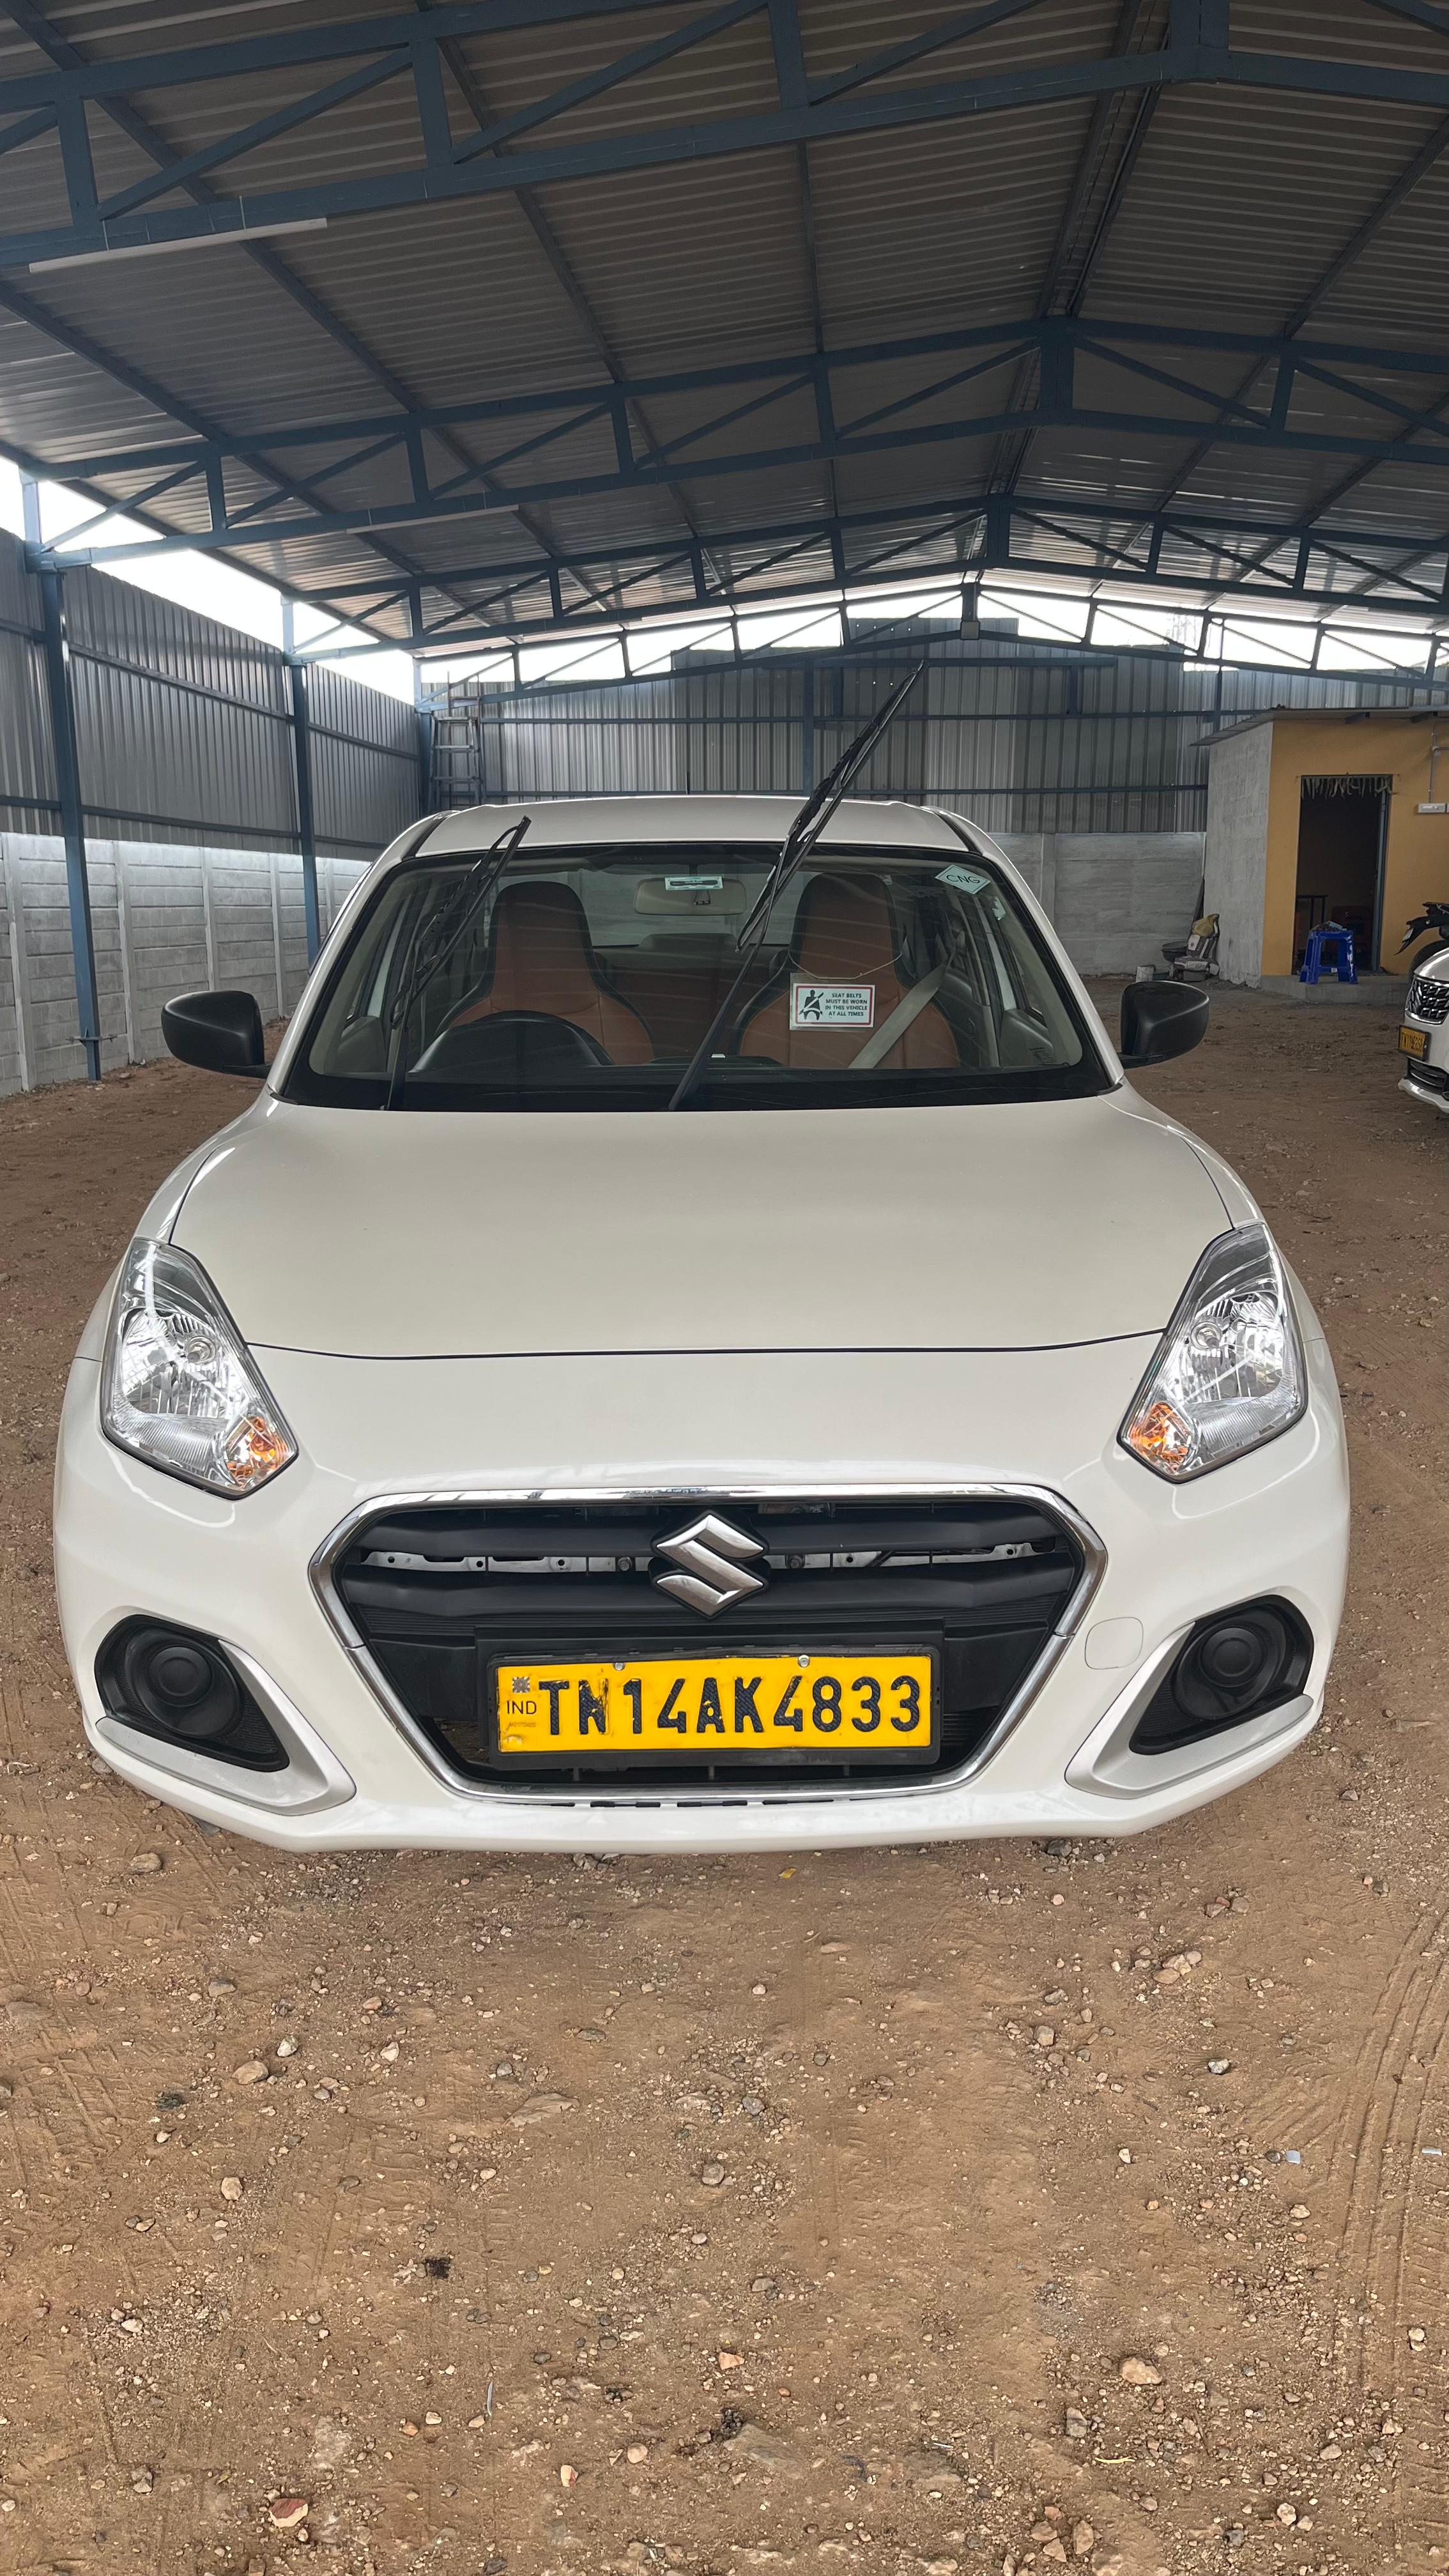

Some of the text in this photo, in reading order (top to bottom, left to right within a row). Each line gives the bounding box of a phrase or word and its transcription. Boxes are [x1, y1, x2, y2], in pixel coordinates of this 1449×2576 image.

[946, 875, 980, 884] CNG
[507, 1700, 537, 1715] IND
[539, 1675, 919, 1735] TN14AK4833
